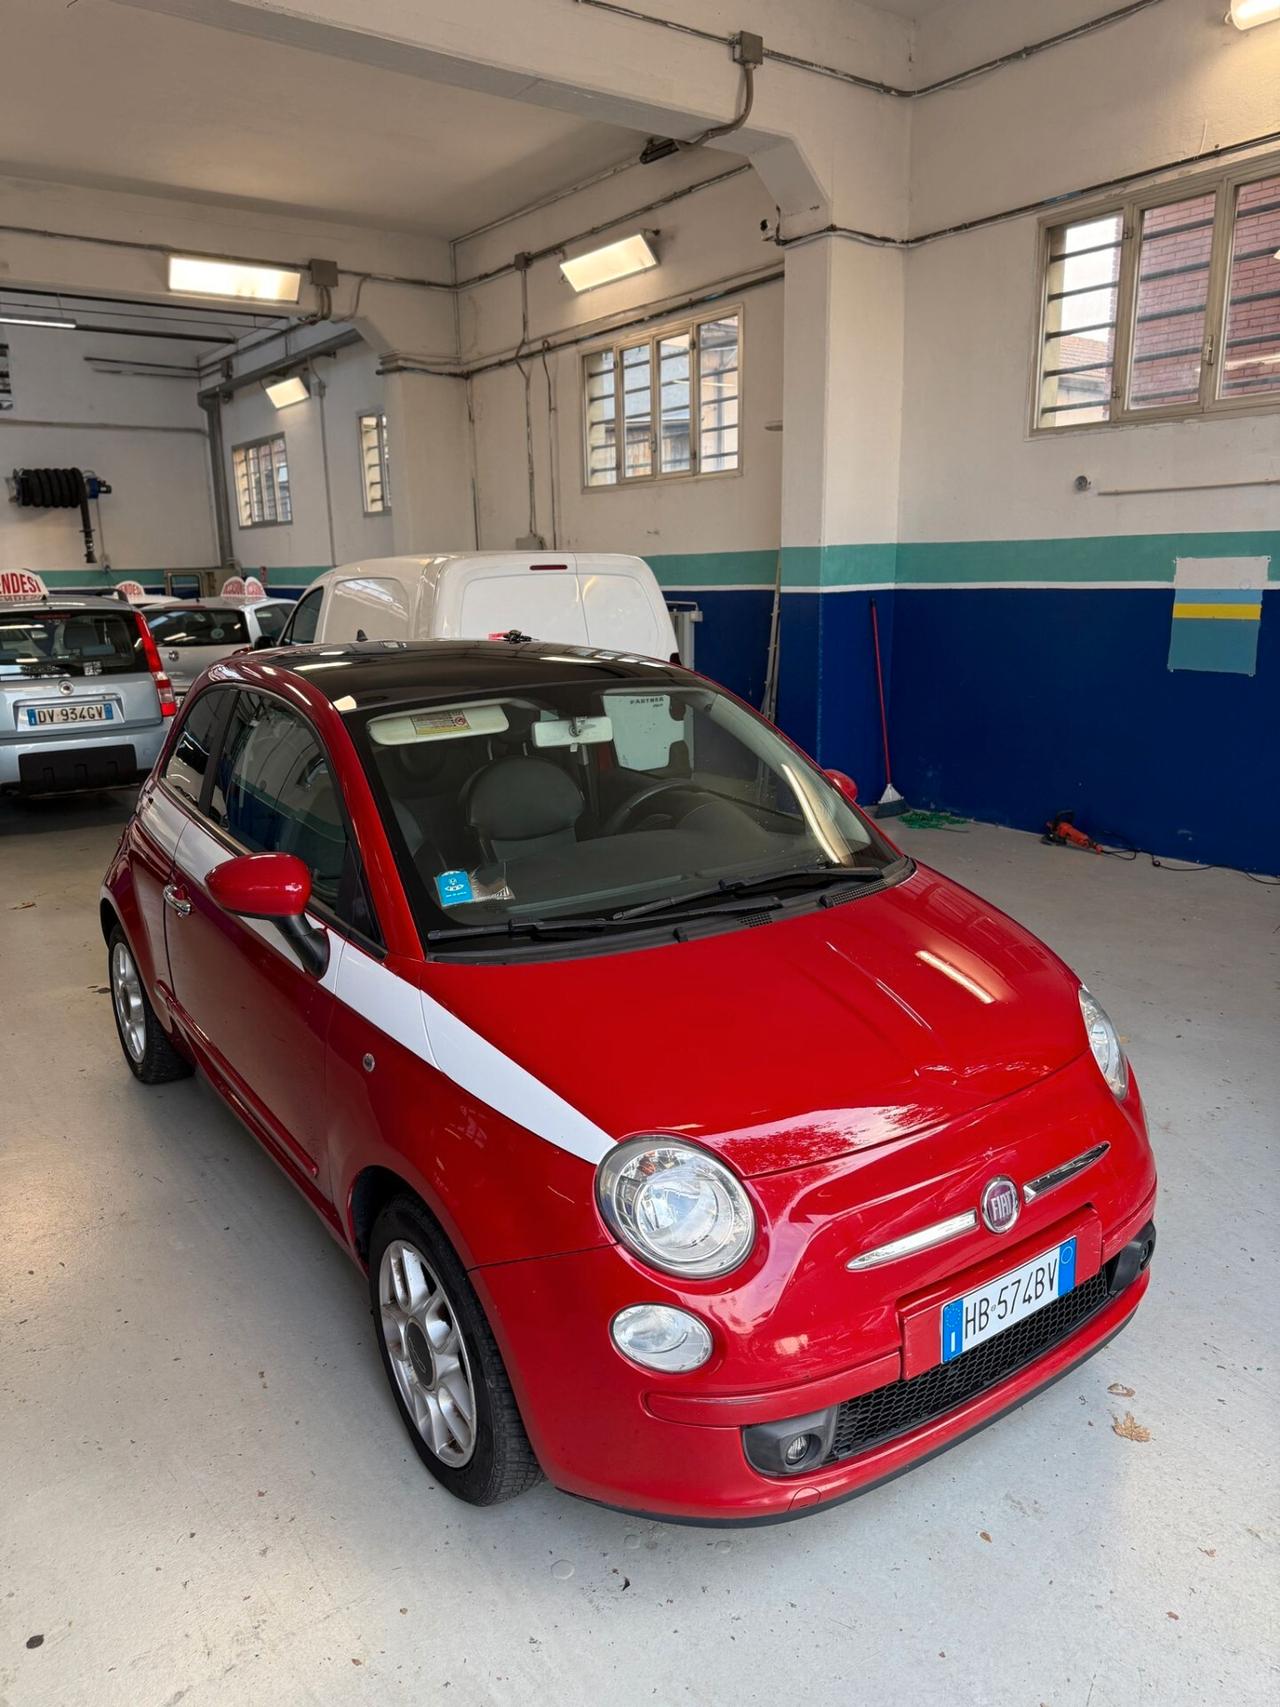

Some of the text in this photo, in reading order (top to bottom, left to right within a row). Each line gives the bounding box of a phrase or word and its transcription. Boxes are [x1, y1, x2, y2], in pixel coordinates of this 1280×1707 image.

[0, 572, 41, 595] NDESI
[37, 709, 54, 724] DV
[60, 705, 103, 722] 934GV
[990, 1190, 1012, 1221] FIAT
[965, 1297, 990, 1340] HB
[997, 1258, 1058, 1320] 574BV
